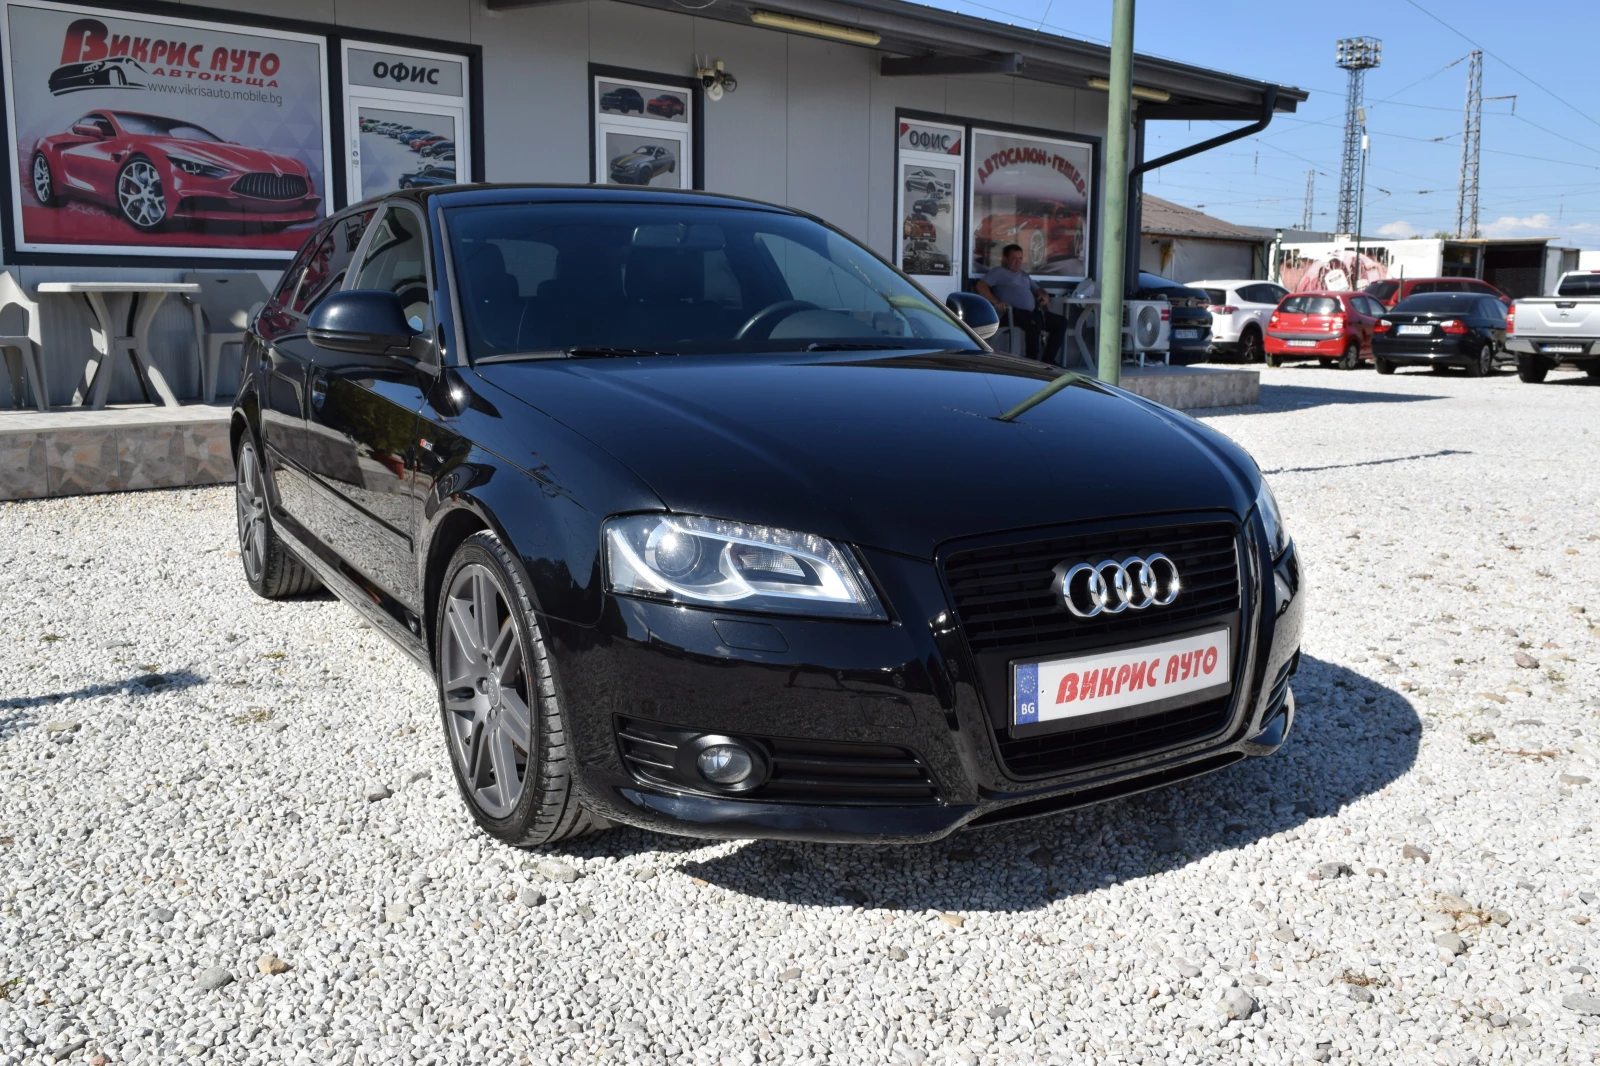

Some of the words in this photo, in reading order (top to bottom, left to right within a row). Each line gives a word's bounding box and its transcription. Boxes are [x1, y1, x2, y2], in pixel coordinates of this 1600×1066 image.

[210, 46, 280, 77] АУТО
[151, 67, 279, 89] АВТОКЪЩА
[148, 82, 283, 107] www.vikrisauto.mobile.bg
[909, 130, 950, 150] ОФИС
[977, 147, 1047, 185] АВТОСАЛОН
[1164, 645, 1218, 684] АУТО
[1021, 702, 1035, 715] BG
